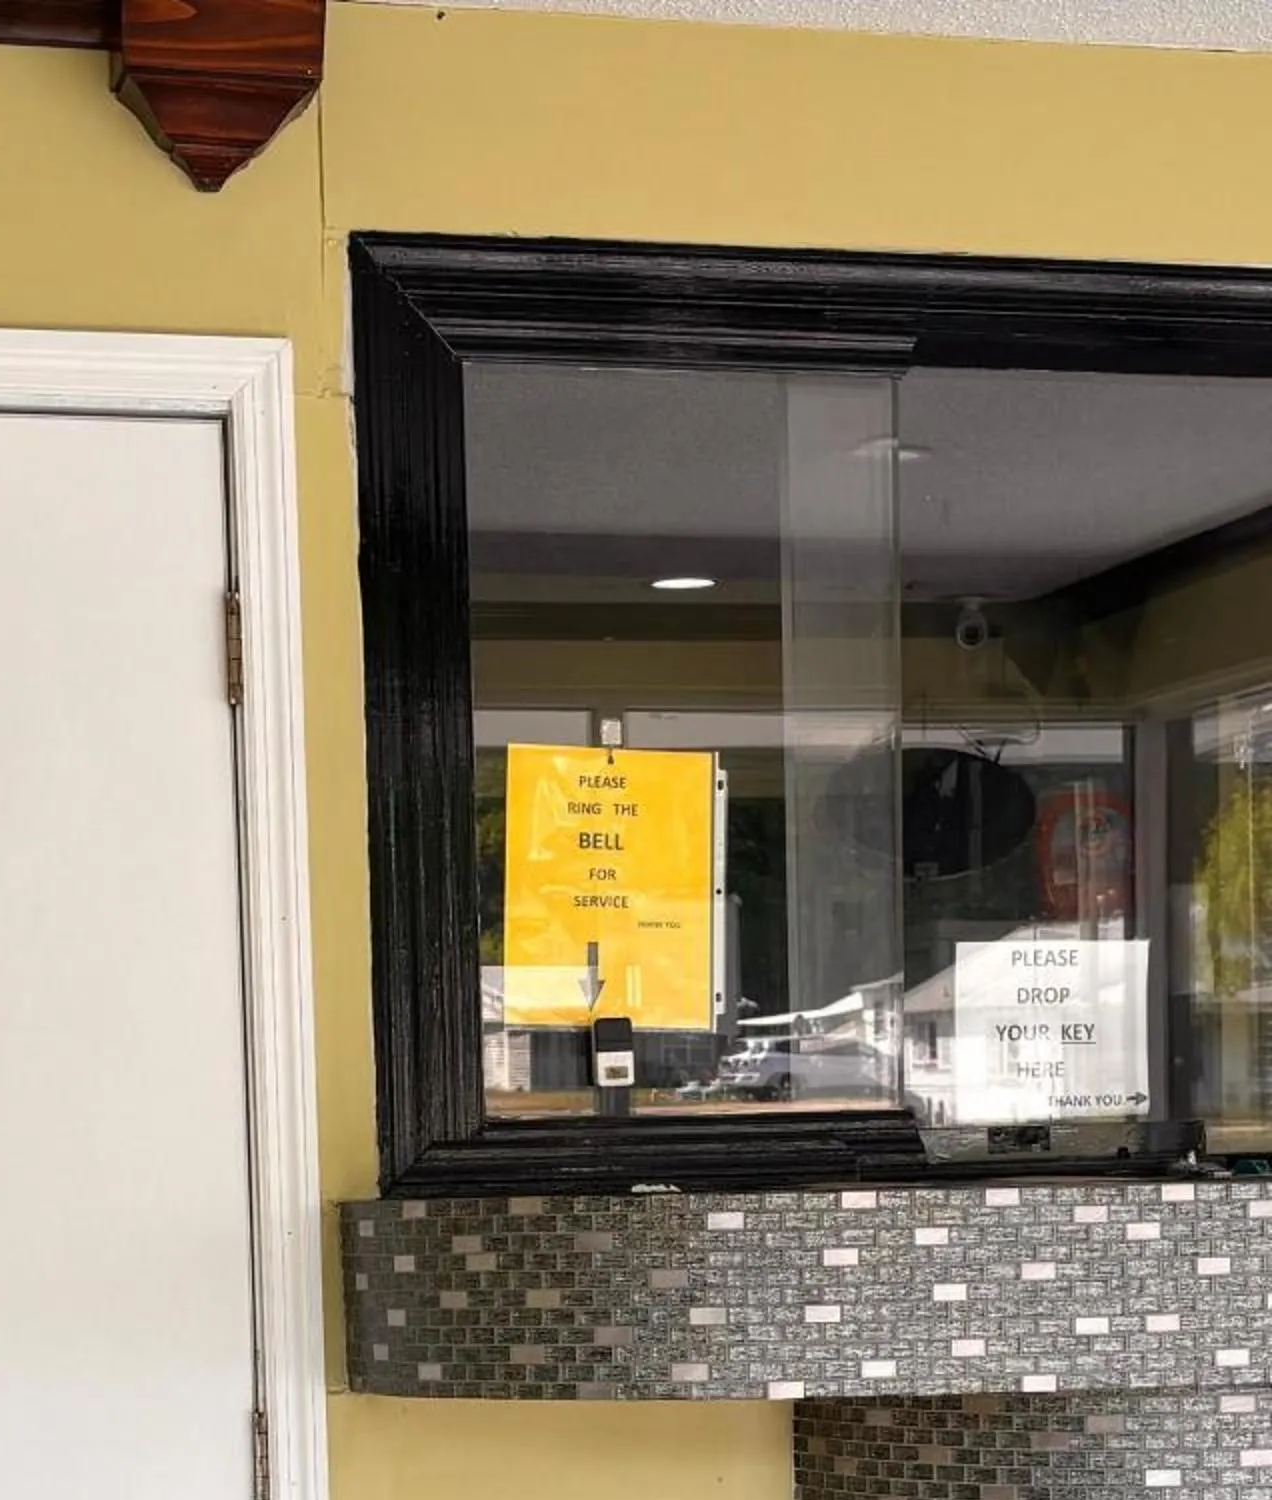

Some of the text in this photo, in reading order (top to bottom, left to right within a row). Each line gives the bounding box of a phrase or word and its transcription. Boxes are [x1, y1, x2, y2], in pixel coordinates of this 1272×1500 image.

[578, 775, 627, 789] PLEASE
[567, 801, 639, 817] RING THE
[579, 832, 624, 850] BELL
[589, 867, 617, 881] FOR
[573, 895, 629, 909] SERVICE
[1012, 950, 1078, 966] PLEASE
[1017, 987, 1070, 1004] DROP
[996, 1023, 1095, 1041] YOUR KEY
[1017, 1062, 1064, 1078] HERE
[1048, 1095, 1091, 1106] THANK
